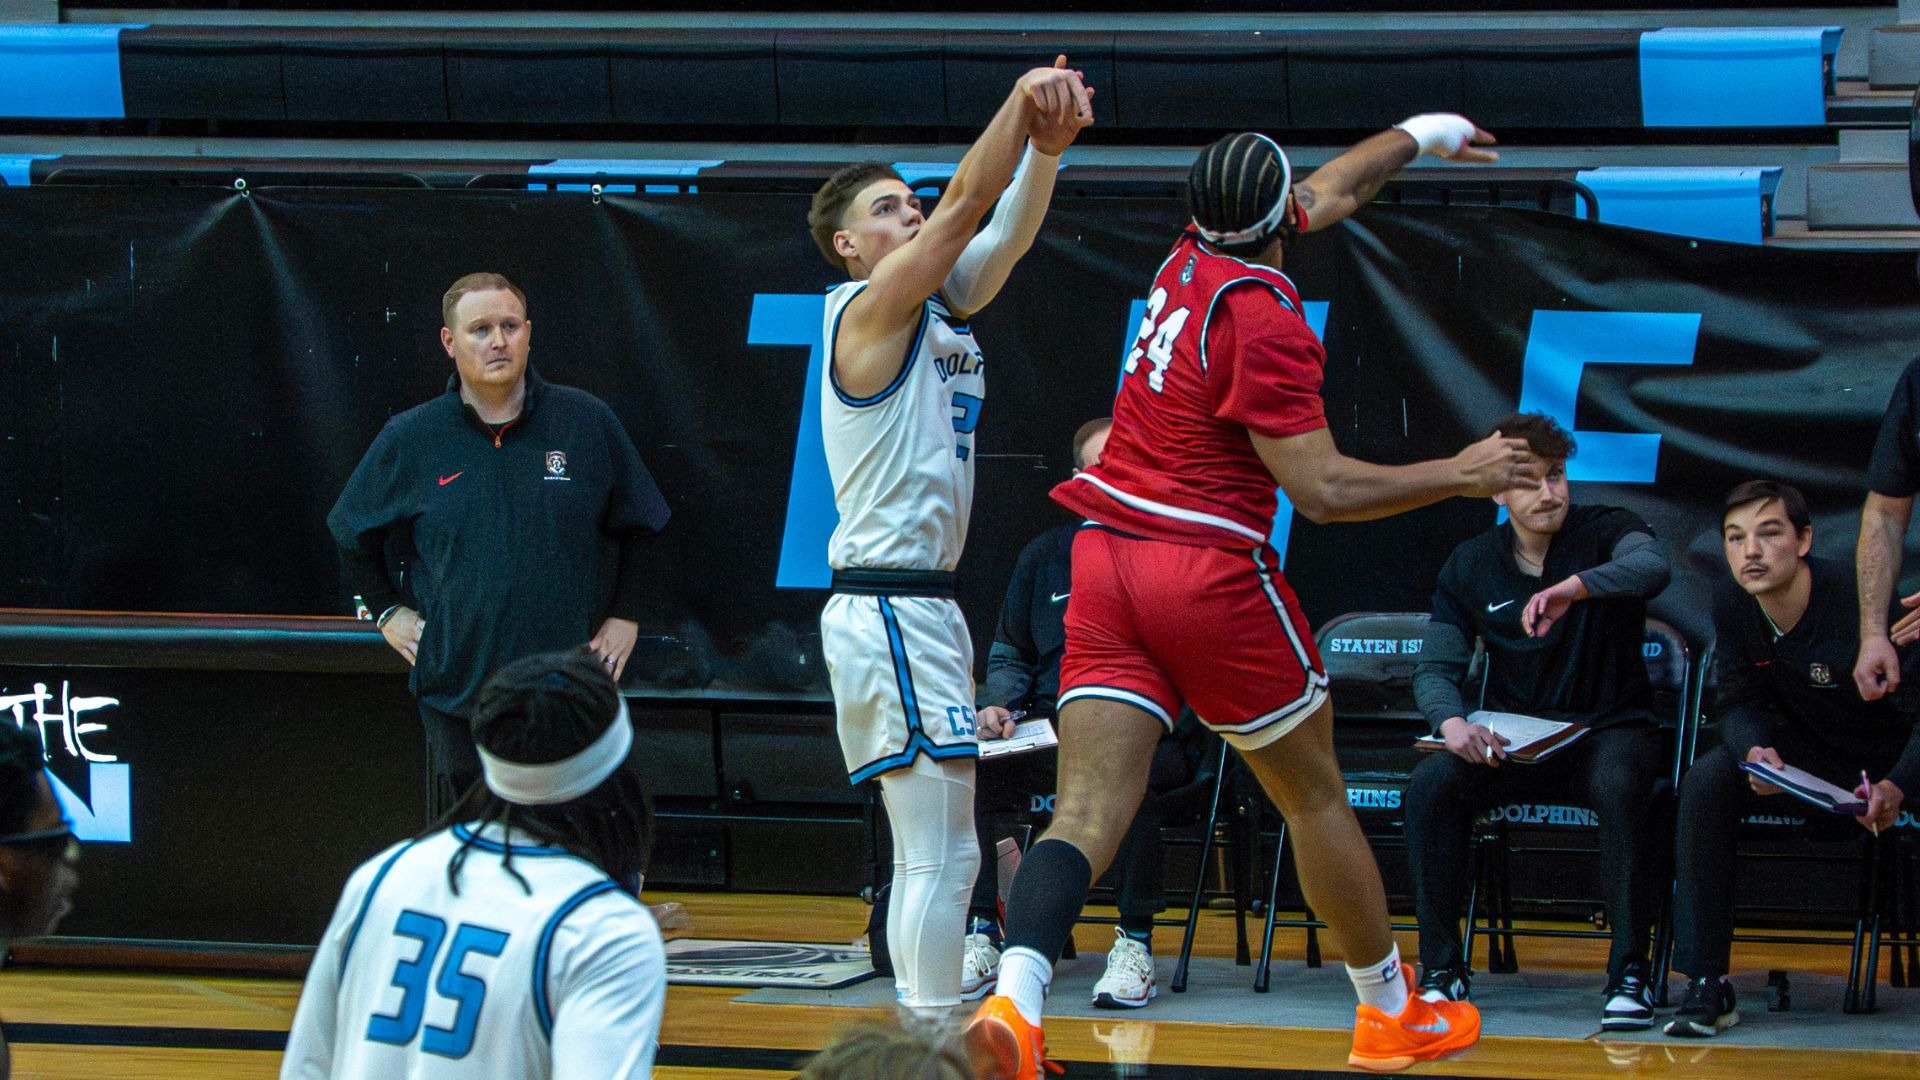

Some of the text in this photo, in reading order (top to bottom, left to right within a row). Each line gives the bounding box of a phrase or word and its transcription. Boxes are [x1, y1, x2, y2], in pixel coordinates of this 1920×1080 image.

[1124, 286, 1191, 393] 24
[1330, 638, 1398, 654] STATEN
[1490, 804, 1599, 826] DOLPHINS
[365, 909, 511, 1060] 35
